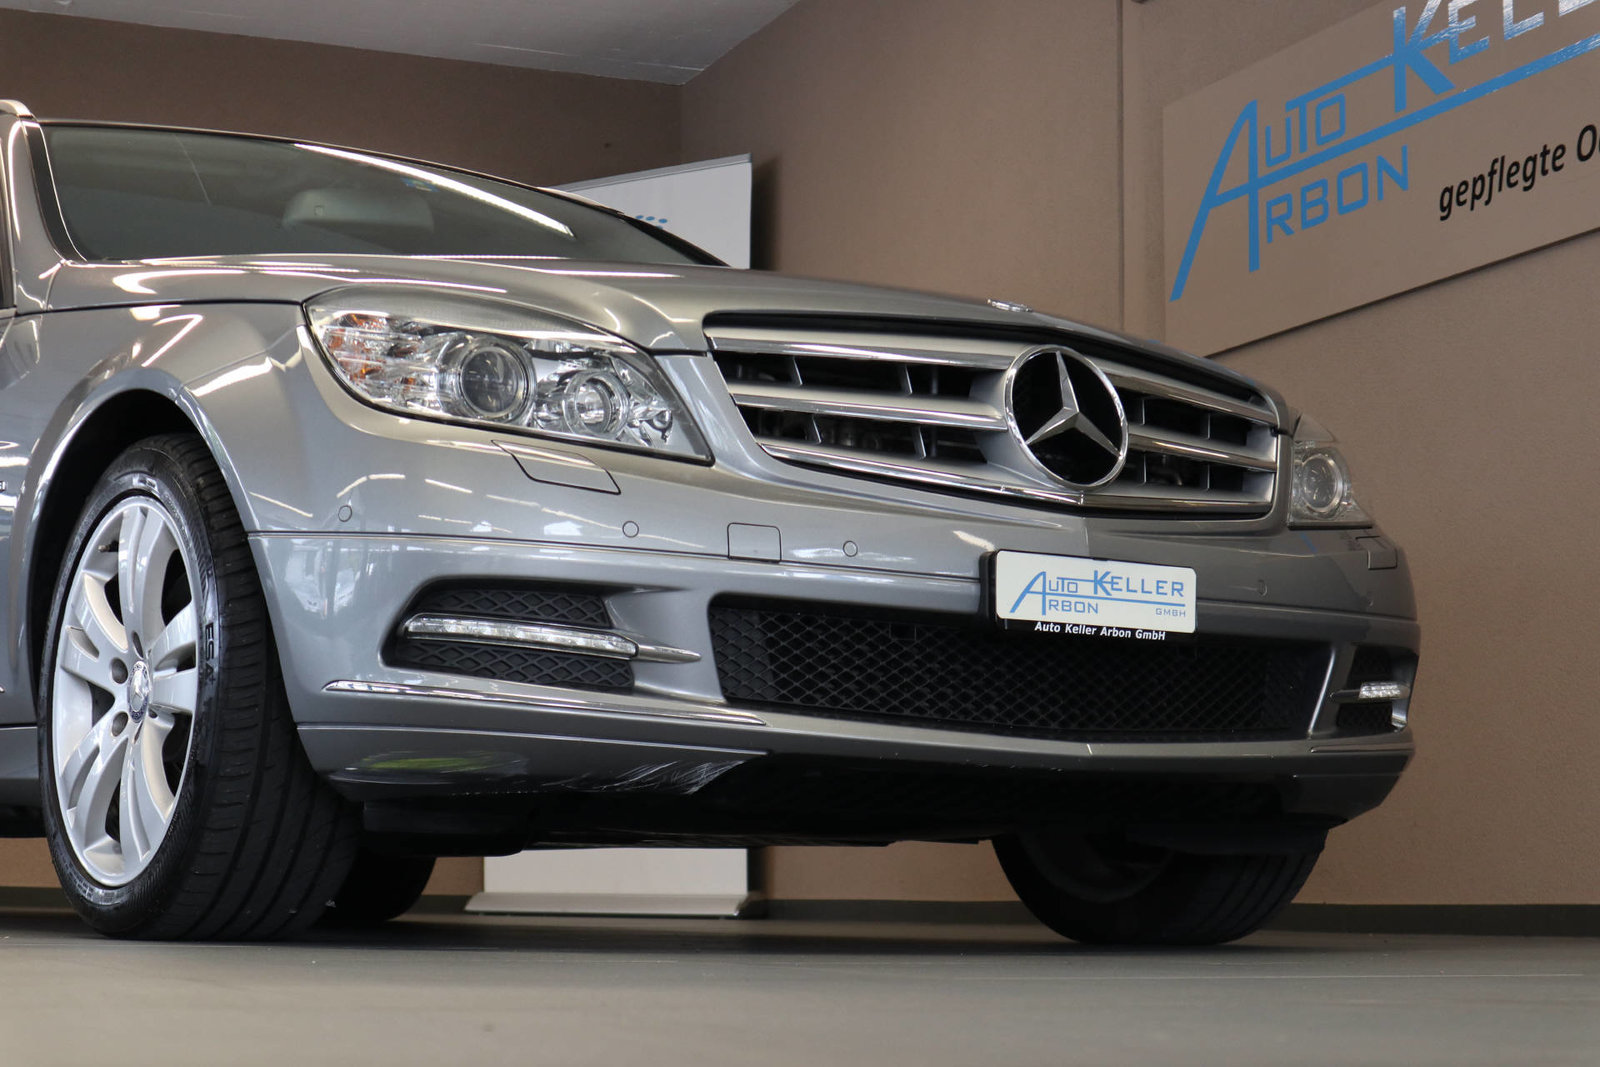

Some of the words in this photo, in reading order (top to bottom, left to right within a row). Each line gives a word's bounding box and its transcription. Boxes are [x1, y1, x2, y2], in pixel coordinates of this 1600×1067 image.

[1393, 0, 1600, 113] KEL
[1439, 143, 1566, 221] gepflegte
[1576, 124, 1600, 162] O
[1093, 570, 1184, 597] KELLER
[1034, 621, 1061, 633] Auto
[1065, 623, 1097, 636] Keller
[1100, 626, 1132, 638] Arbon
[1135, 629, 1166, 641] GmbH
